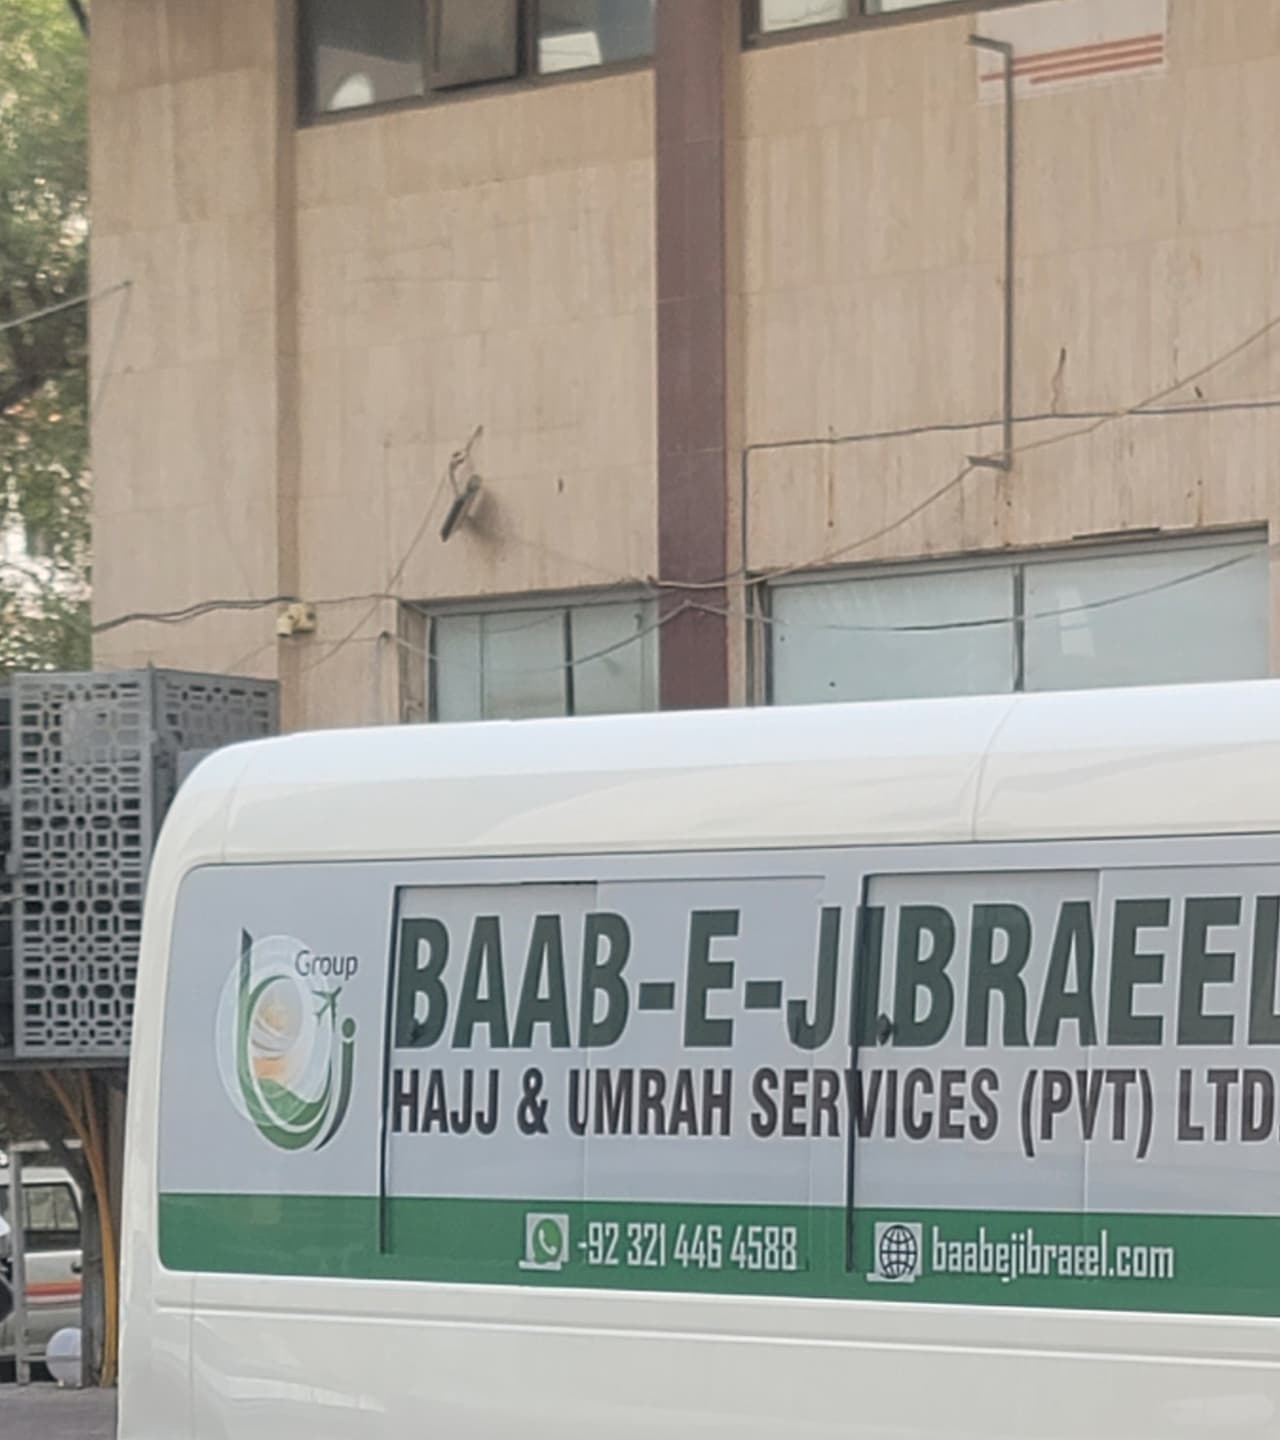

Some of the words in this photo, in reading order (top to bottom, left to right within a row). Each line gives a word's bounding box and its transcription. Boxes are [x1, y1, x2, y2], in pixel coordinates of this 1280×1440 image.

[295, 949, 358, 979] Group
[391, 1068, 499, 1135] HAJJ
[516, 1067, 549, 1135] &
[568, 1068, 732, 1137] UMRAH
[750, 1067, 999, 1140] SERVICES
[1021, 1068, 1154, 1158] (PVT)
[627, 1222, 667, 1267] 321
[673, 1223, 722, 1268] 446
[730, 1225, 797, 1270] 4588
[932, 1225, 1174, 1282] baabejibraeel.com
